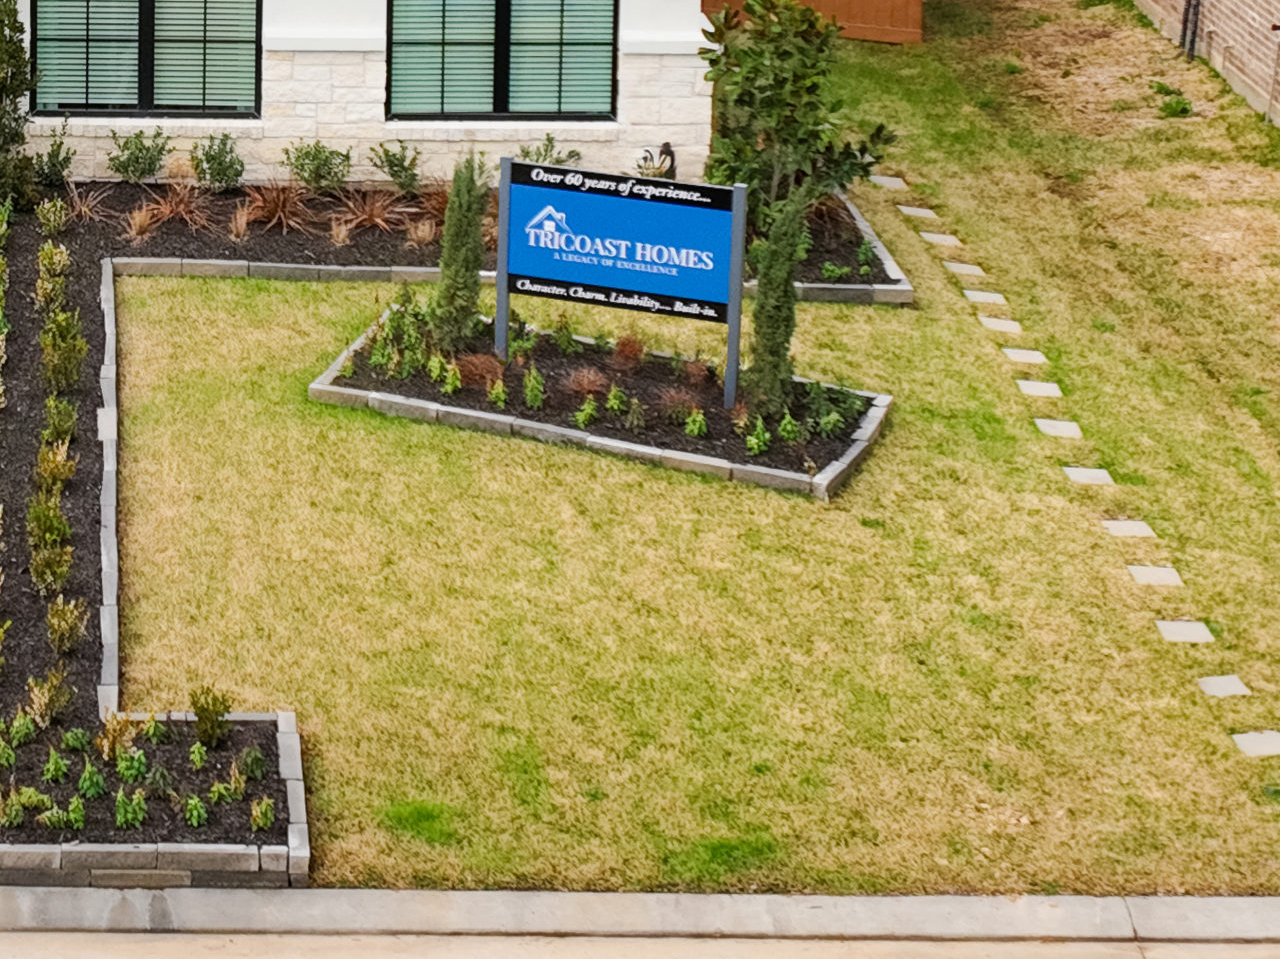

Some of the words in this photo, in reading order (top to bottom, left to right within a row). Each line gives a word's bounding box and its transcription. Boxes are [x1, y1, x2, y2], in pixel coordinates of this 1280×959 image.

[531, 168, 563, 183] Over
[564, 173, 583, 187] 60
[584, 177, 616, 191] years
[617, 179, 636, 196] of
[526, 228, 631, 259] TRICOAST
[635, 243, 714, 270] HOMES
[553, 252, 560, 260] A
[562, 253, 600, 266] LEGACY
[601, 258, 614, 267] OF
[616, 260, 678, 276] EXCELLENCE
